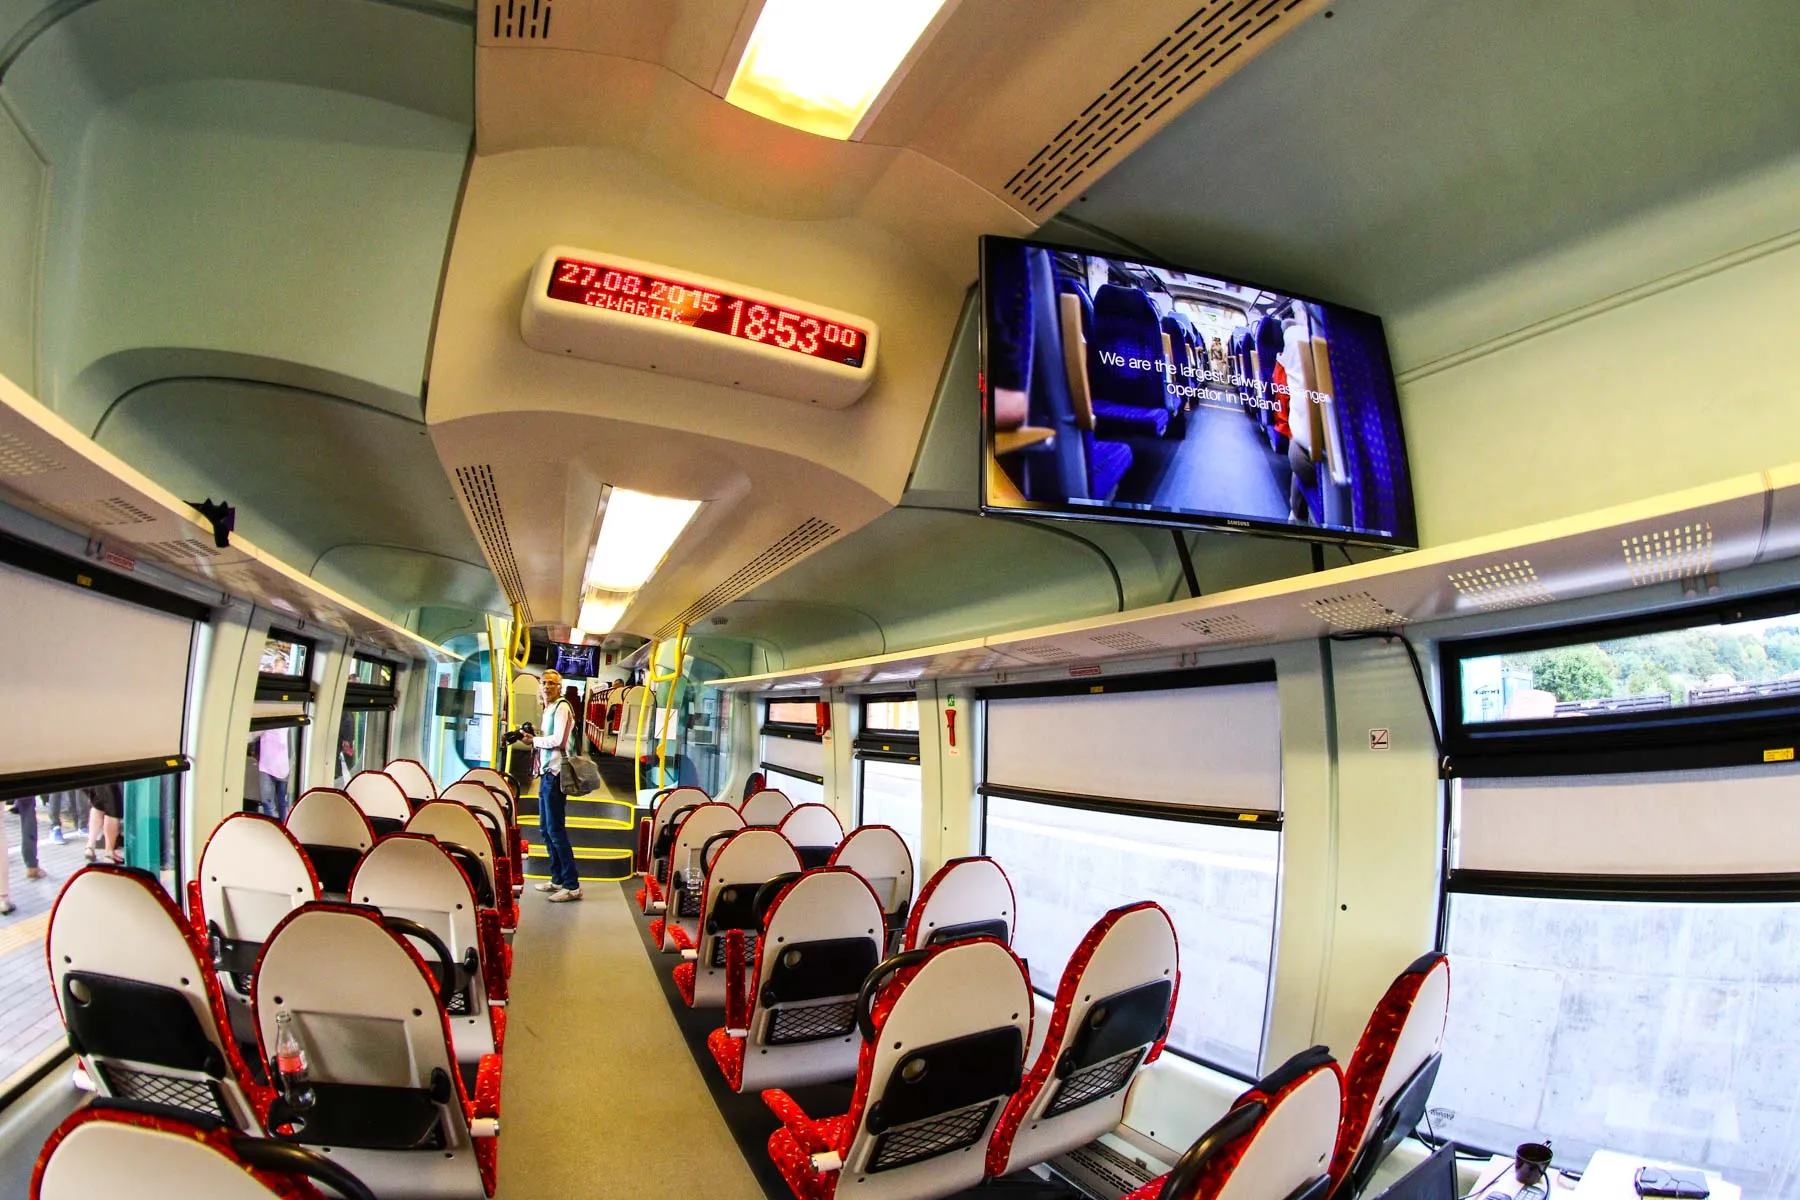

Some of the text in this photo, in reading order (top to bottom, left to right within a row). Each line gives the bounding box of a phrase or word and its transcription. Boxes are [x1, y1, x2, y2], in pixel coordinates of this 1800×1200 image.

[559, 263, 720, 312] 27.08.2015
[585, 291, 685, 323] CZWARTEK
[728, 300, 820, 354] 18:53
[1098, 350, 1330, 404] We are the largest railway pasnger
[1166, 383, 1282, 412] operator in Poland
